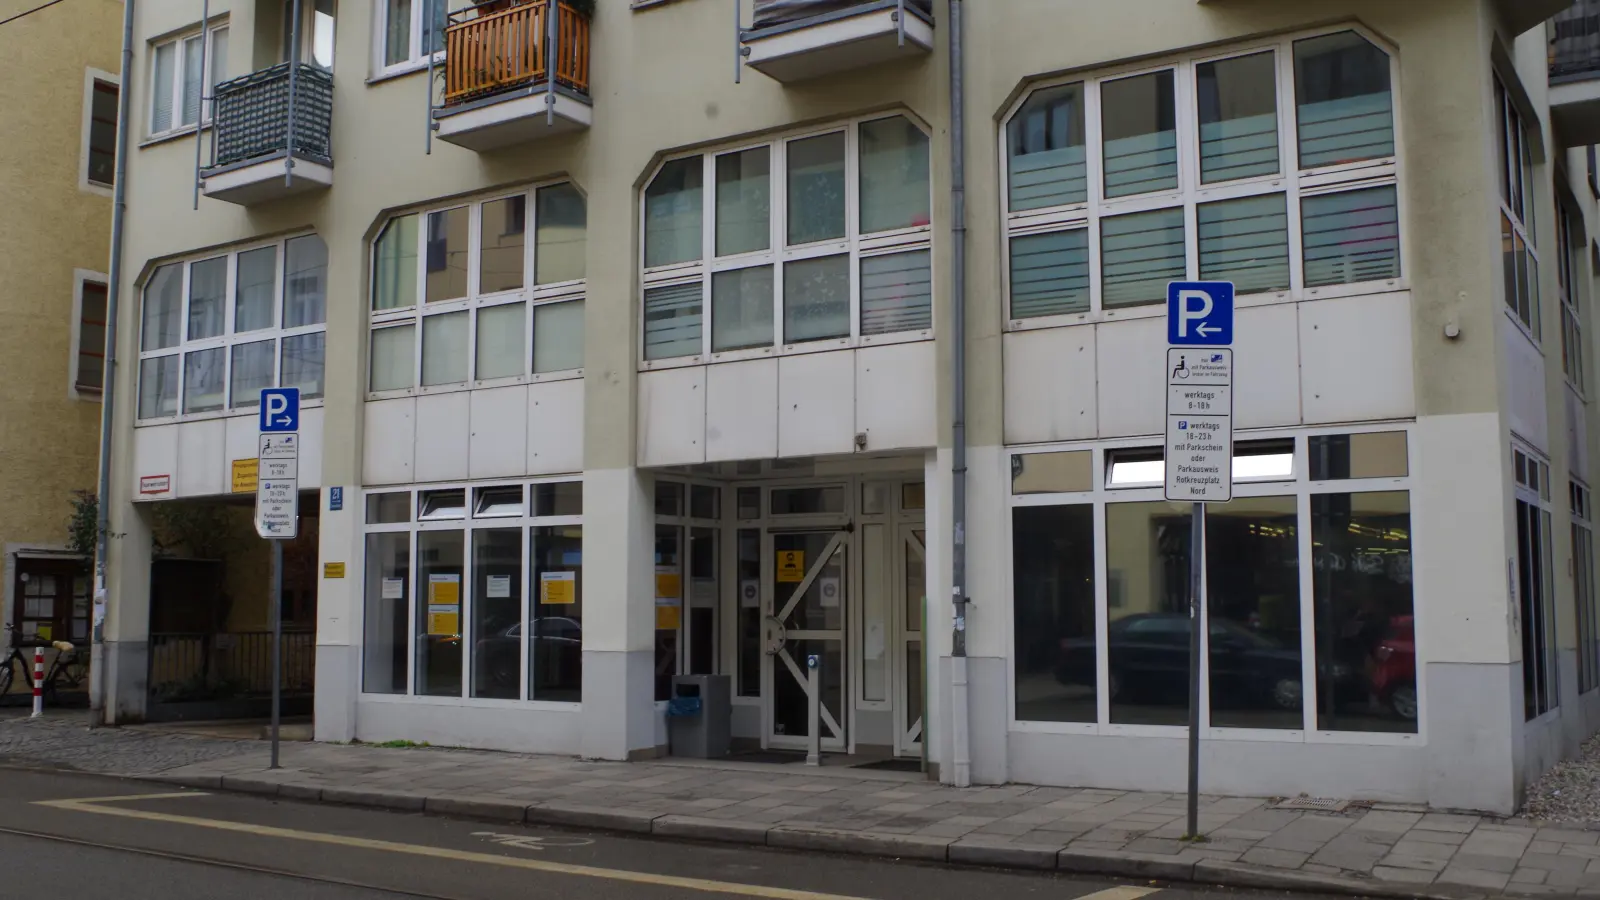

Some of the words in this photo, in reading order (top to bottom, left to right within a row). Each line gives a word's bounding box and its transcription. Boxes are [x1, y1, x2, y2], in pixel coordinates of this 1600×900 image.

[1178, 289, 1213, 337] P
[1184, 390, 1215, 400] werktags
[266, 393, 288, 427] P
[1190, 421, 1220, 431] werktags
[1186, 443, 1223, 452] Parkschein
[1178, 464, 1219, 473] Parkausweis
[1176, 476, 1220, 485] Rotkreuzplatz
[332, 488, 340, 500] 21
[1190, 487, 1206, 495] Nord
